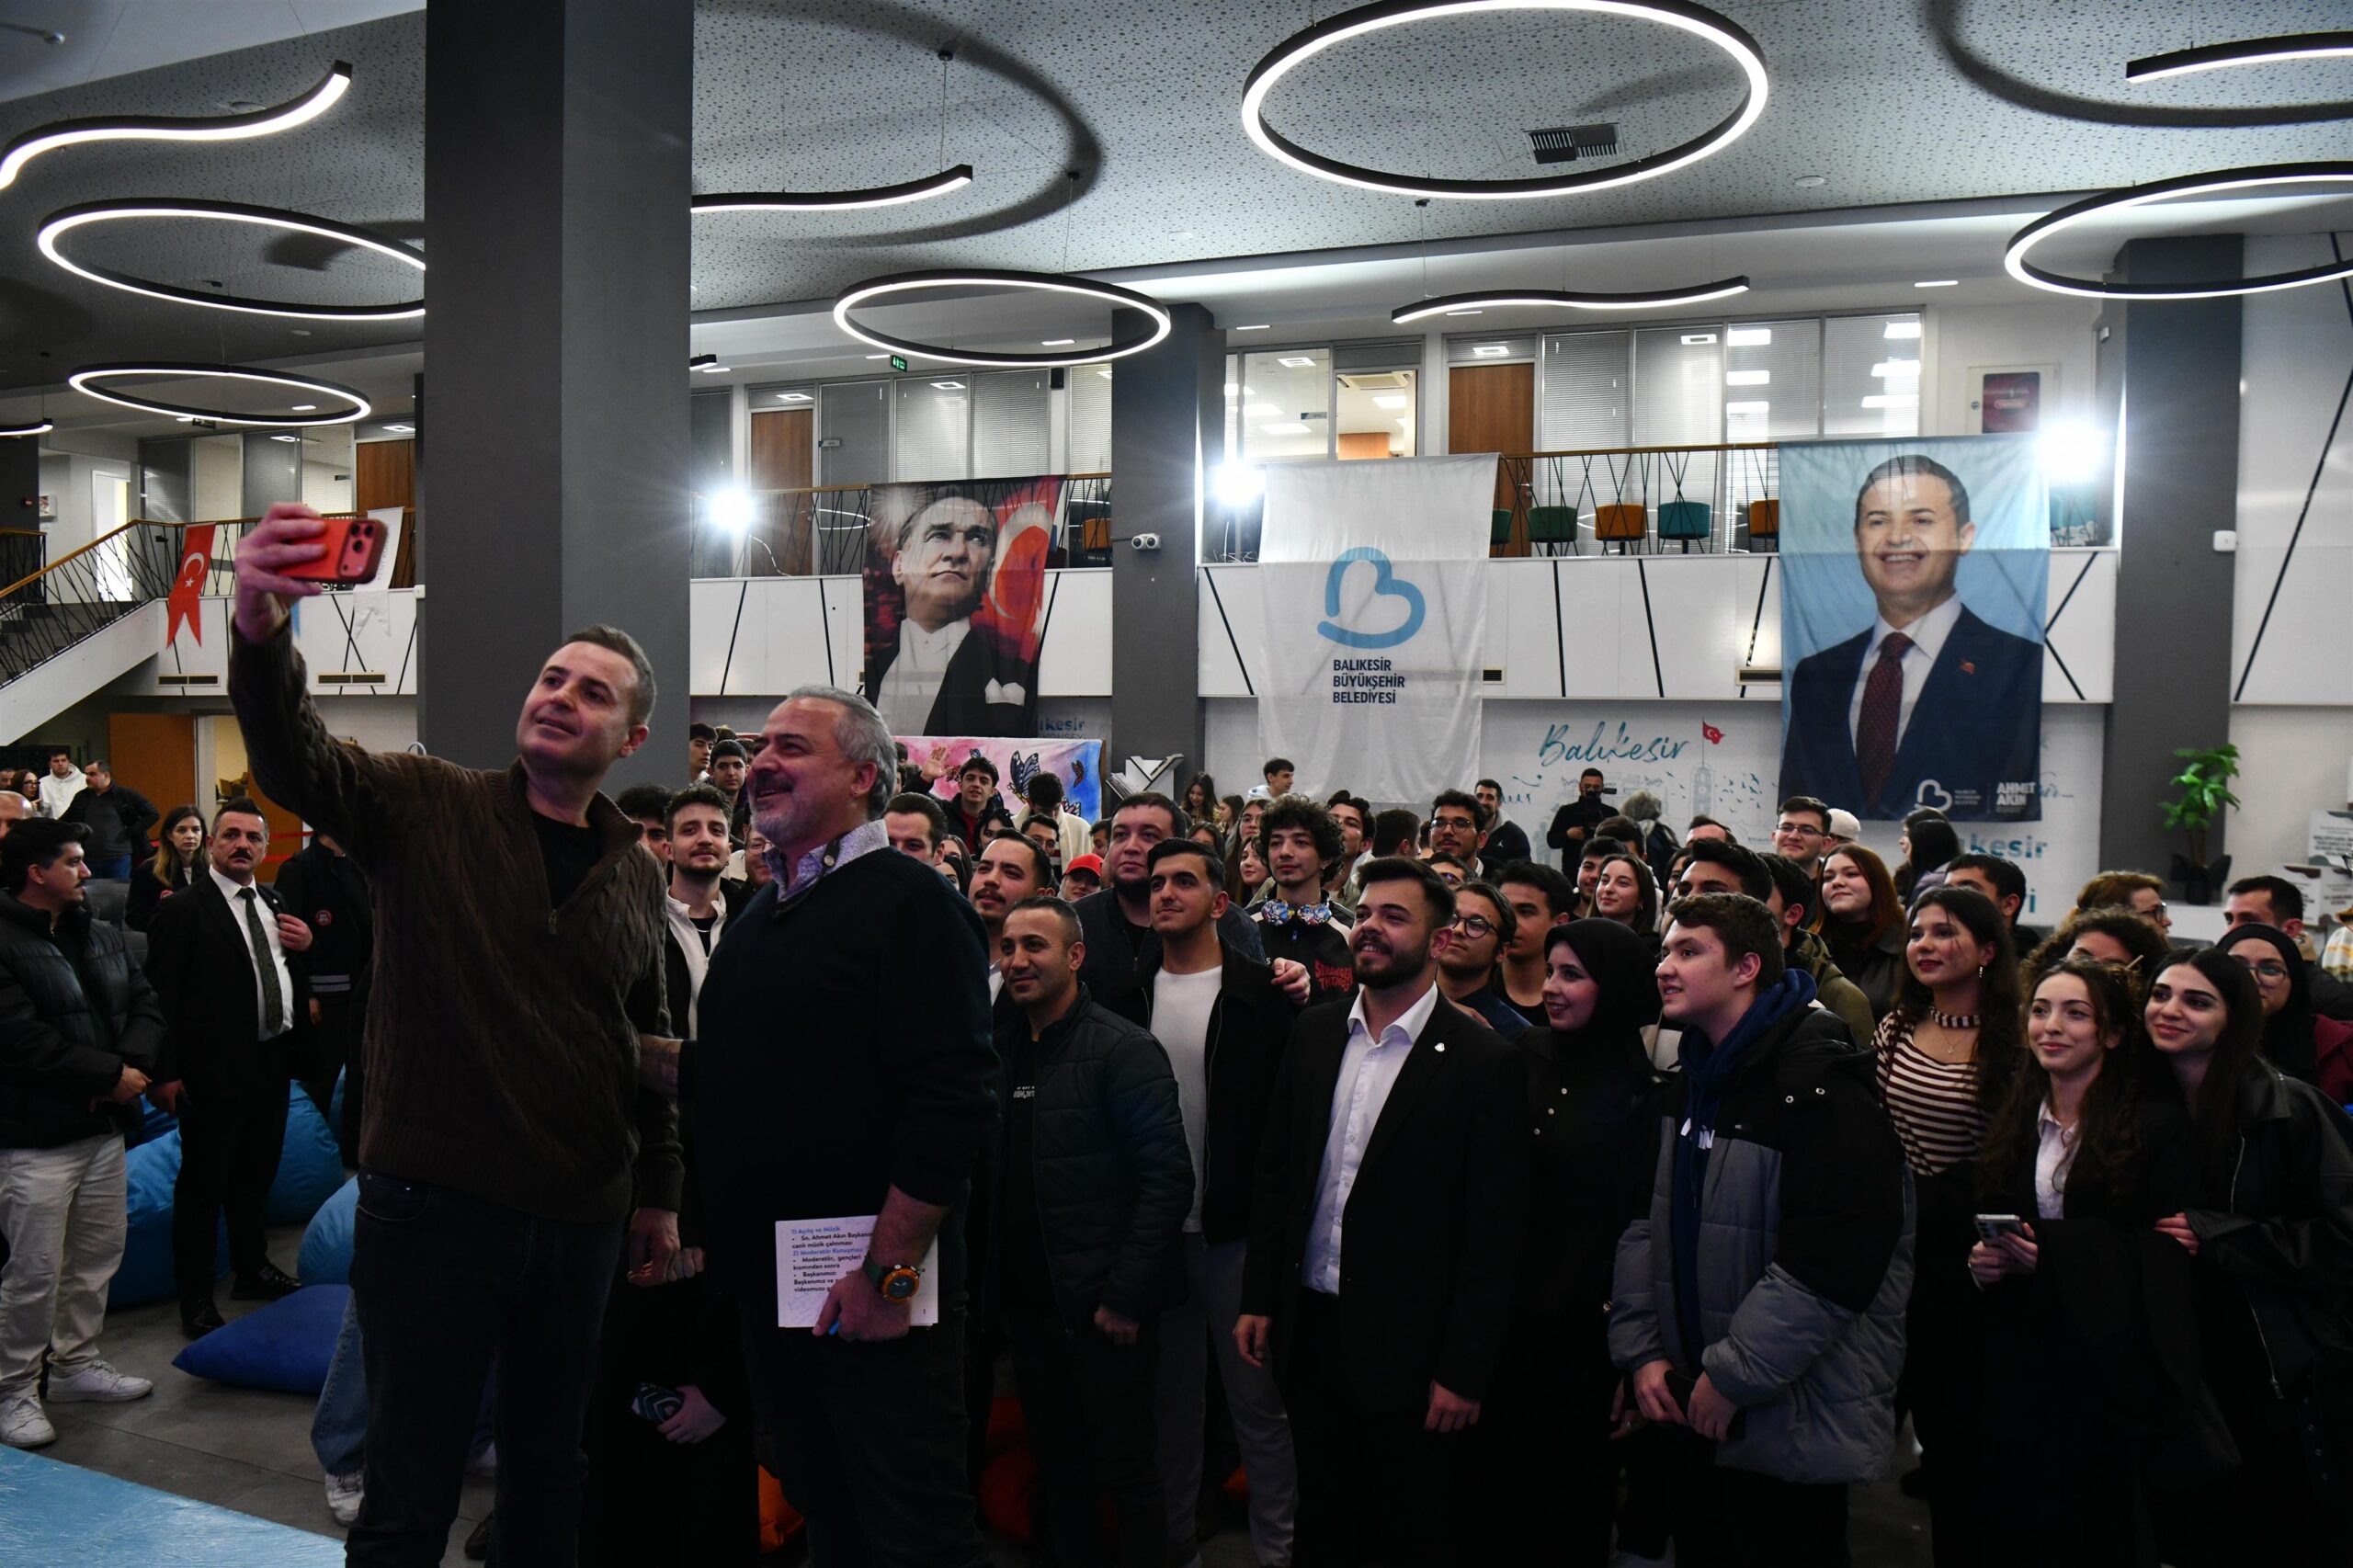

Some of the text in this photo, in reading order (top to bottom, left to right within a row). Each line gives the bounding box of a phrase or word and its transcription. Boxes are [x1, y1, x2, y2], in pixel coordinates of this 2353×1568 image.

[1334, 657, 1392, 672] BALIKESİR
[1333, 673, 1405, 689] BÜYÜKŞEHİR
[1333, 689, 1396, 704] BELEDİYESİ
[1996, 782, 2036, 794] AHMET
[1314, 959, 1353, 984] STRANGER
[1319, 976, 1350, 993] THINGS
